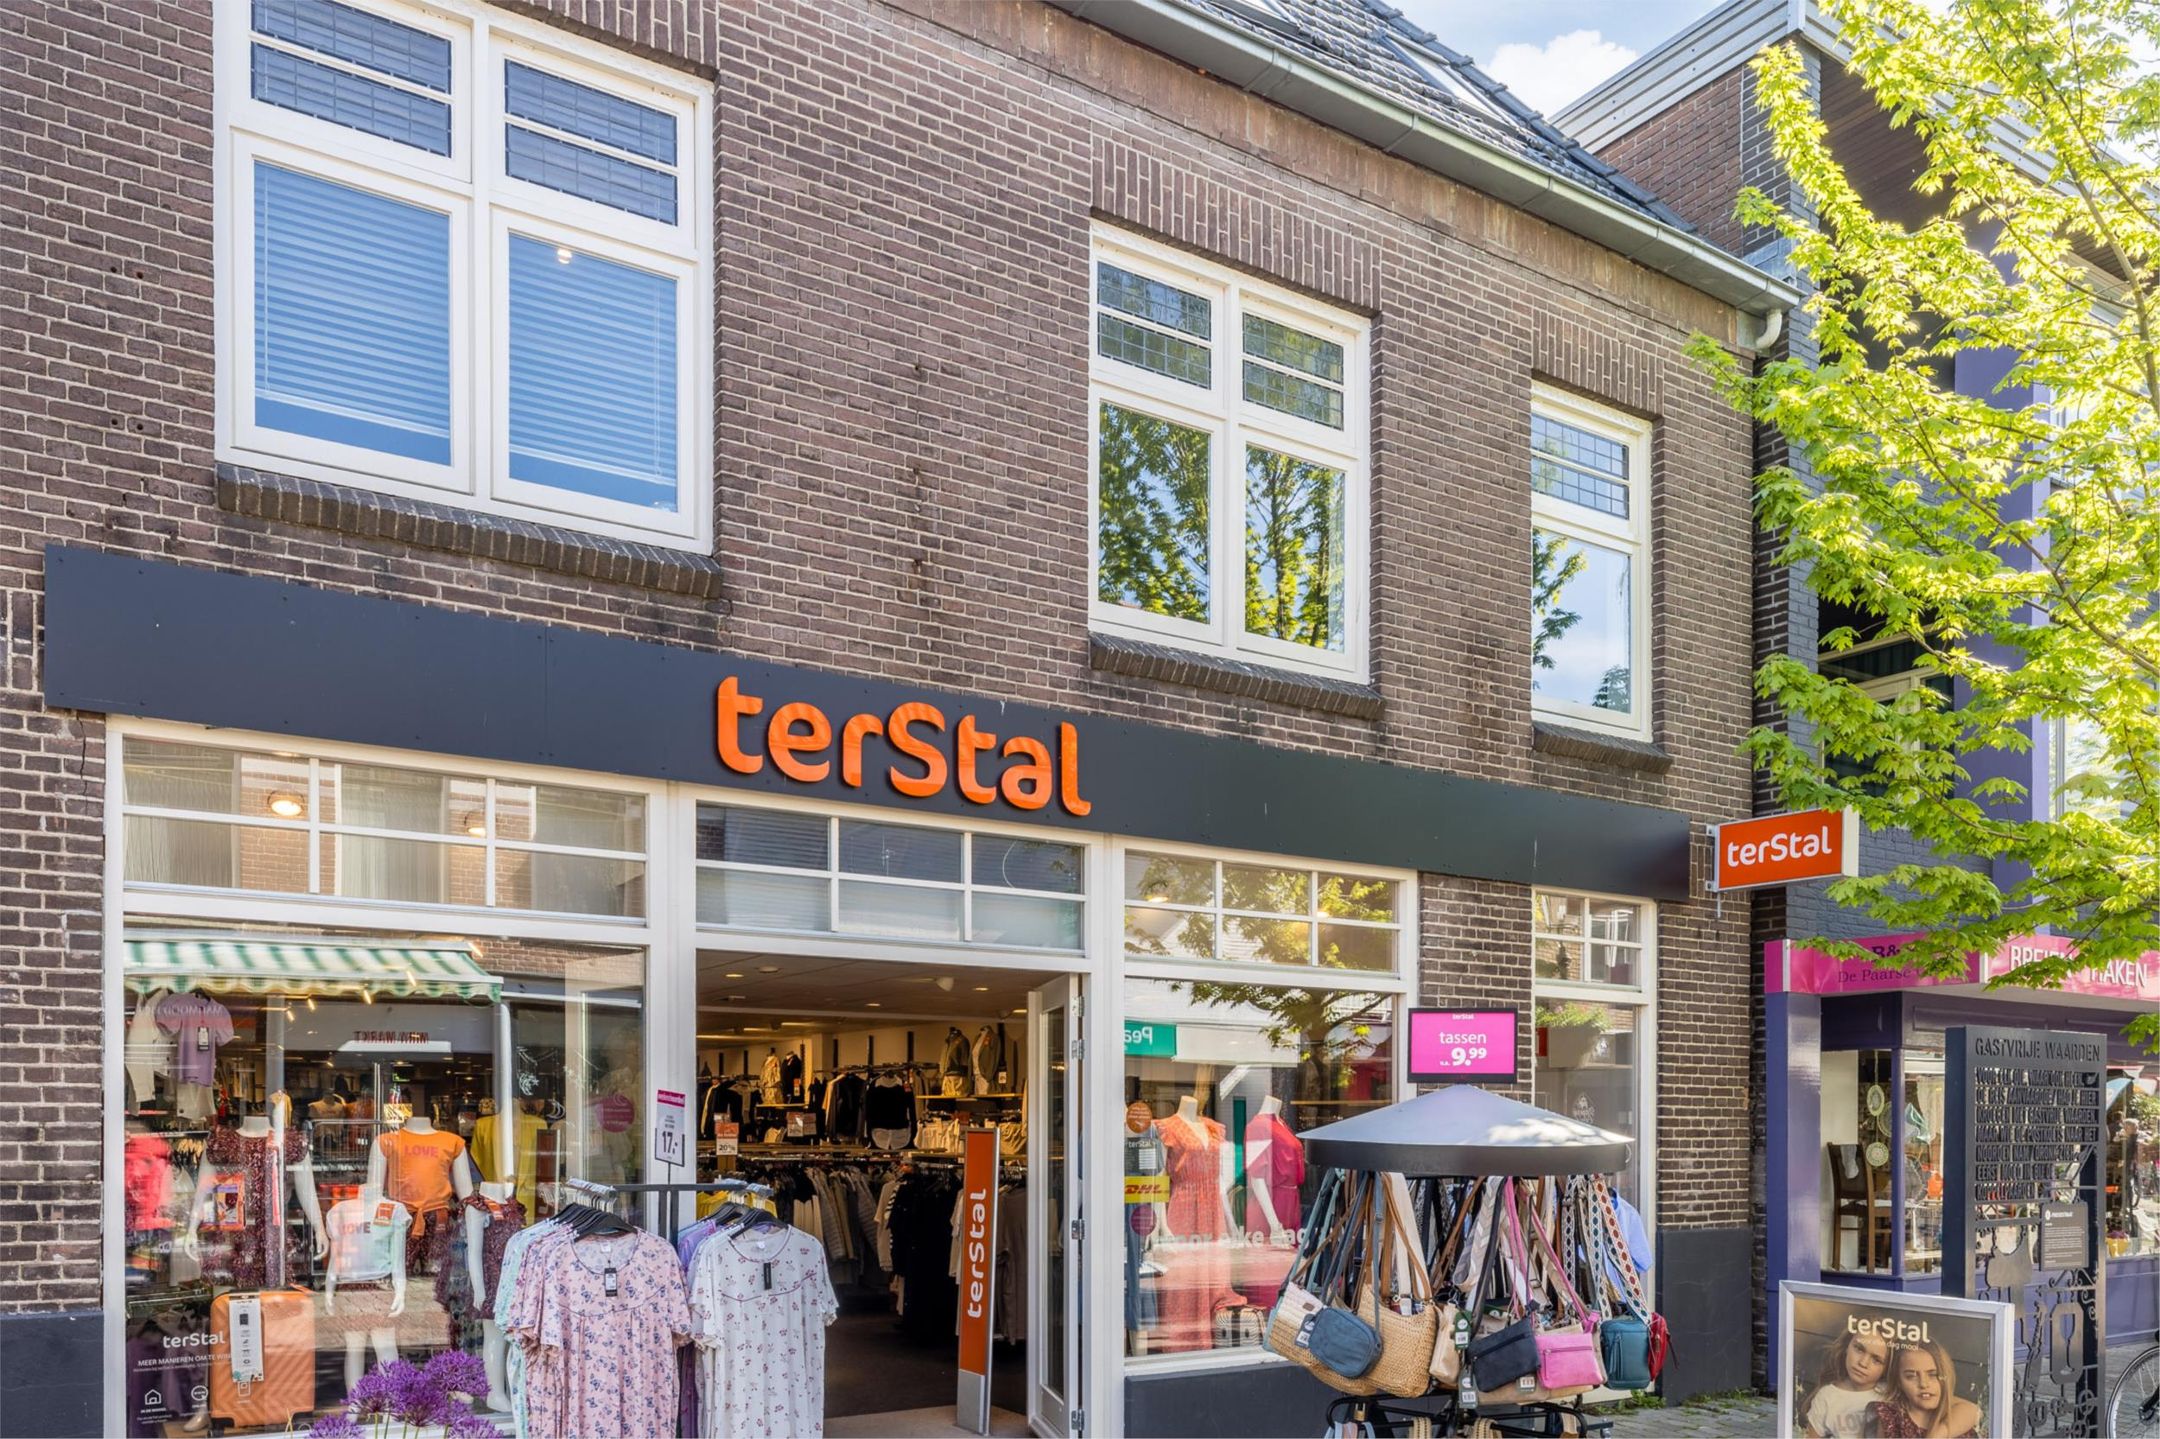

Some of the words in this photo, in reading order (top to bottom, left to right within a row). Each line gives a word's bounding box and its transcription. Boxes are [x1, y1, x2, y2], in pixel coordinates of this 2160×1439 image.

[716, 675, 1092, 817] terStal
[1727, 825, 1832, 868] terStal
[1838, 970, 1857, 983] De
[1439, 1031, 1487, 1044] tassen
[1975, 1038, 2040, 1059] GASTVRIJE
[2045, 1041, 2100, 1062] WAARDEN
[404, 1145, 438, 1158] LOVE
[1125, 1184, 1162, 1194] DHL
[340, 1222, 371, 1235] LOVE
[967, 1187, 987, 1319] terStal
[1847, 1314, 1931, 1343] terStal
[162, 1330, 226, 1349] terStal
[137, 1358, 160, 1367] MEER
[159, 1356, 194, 1365] MANIEREN
